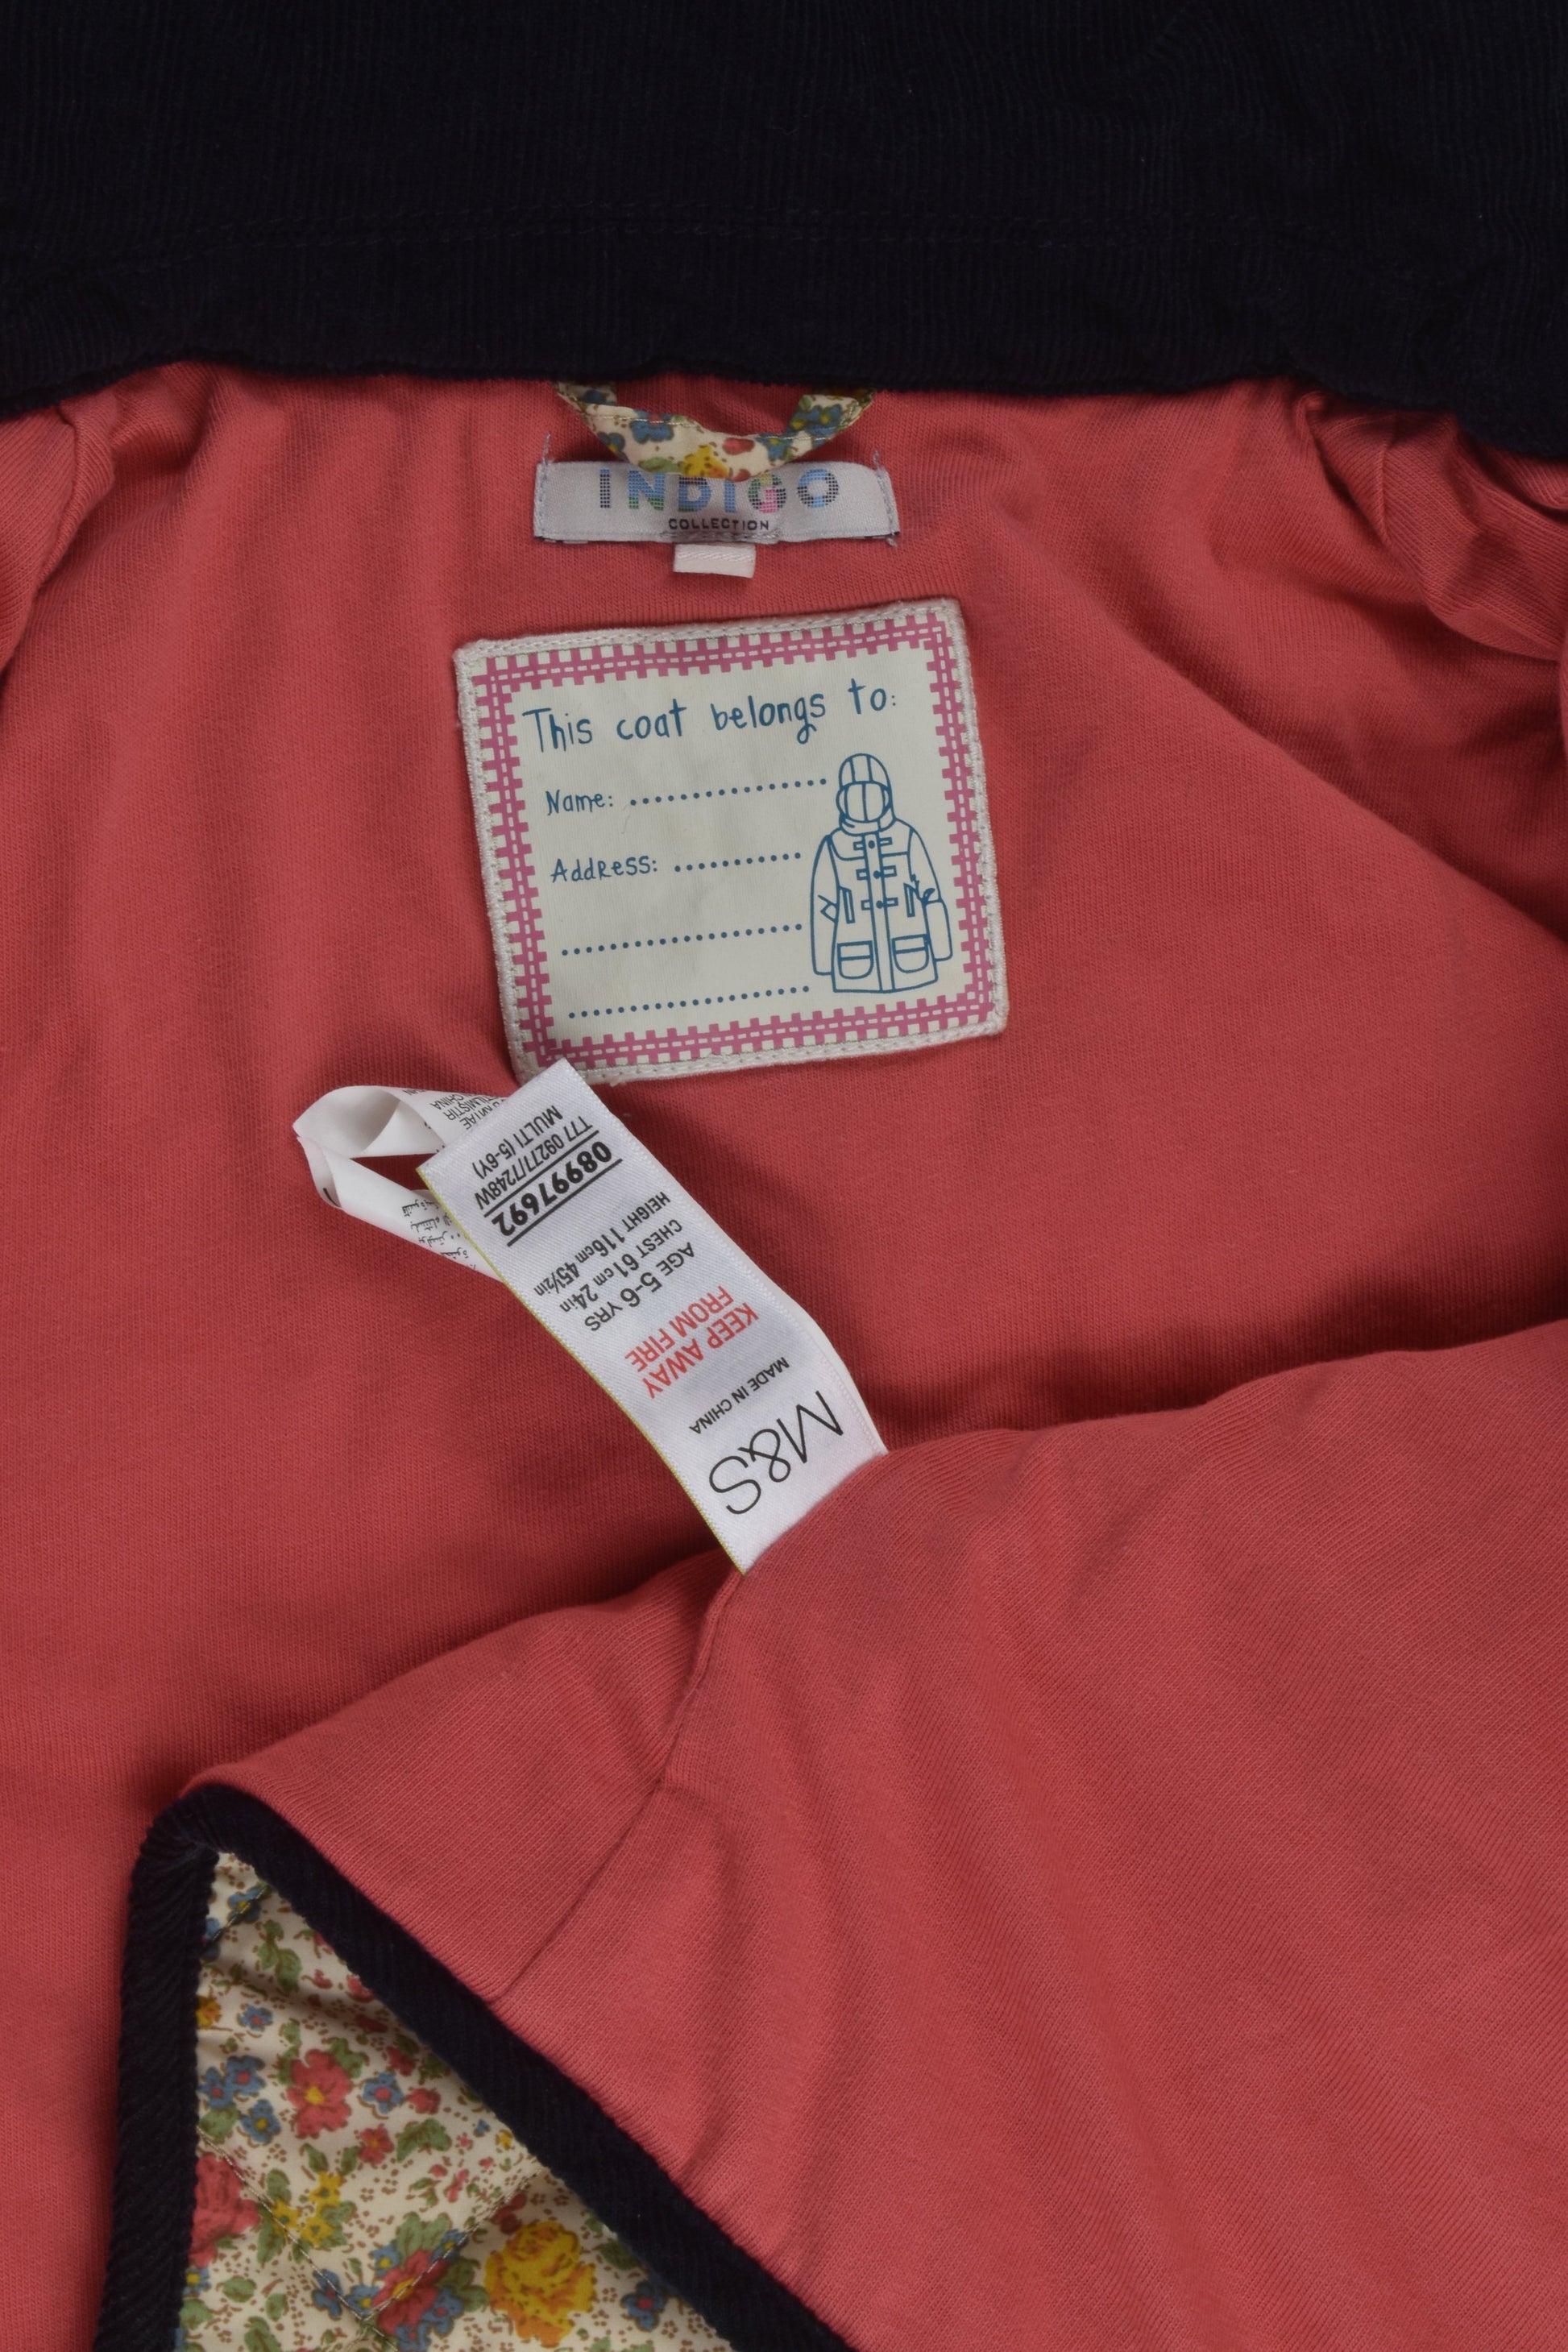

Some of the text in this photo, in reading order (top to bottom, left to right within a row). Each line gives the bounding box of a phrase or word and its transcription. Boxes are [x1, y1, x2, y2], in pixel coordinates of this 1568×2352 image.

[599, 469, 839, 513] INDIGO
[668, 518, 769, 532] COLLECTION
[522, 678, 897, 753] This coat belongs to:
[545, 788, 614, 815] Name:
[472, 1105, 563, 1179] MULTI (5-6Y)
[475, 1116, 593, 1210] T77 09277/7248W
[491, 1141, 612, 1236] 08997692
[621, 1191, 671, 1233] HEIGHT
[575, 1227, 625, 1263] 116cm
[636, 1219, 682, 1259] CHEST
[559, 1284, 599, 1313] 24in
[584, 1242, 695, 1331] AGE 5-6 YRS
[624, 1285, 734, 1372] FROM FIRE
[643, 1302, 759, 1399] KEEP AWAY
[689, 1357, 790, 1434] MADE IN CHINA
[709, 1391, 843, 1515] M&S
